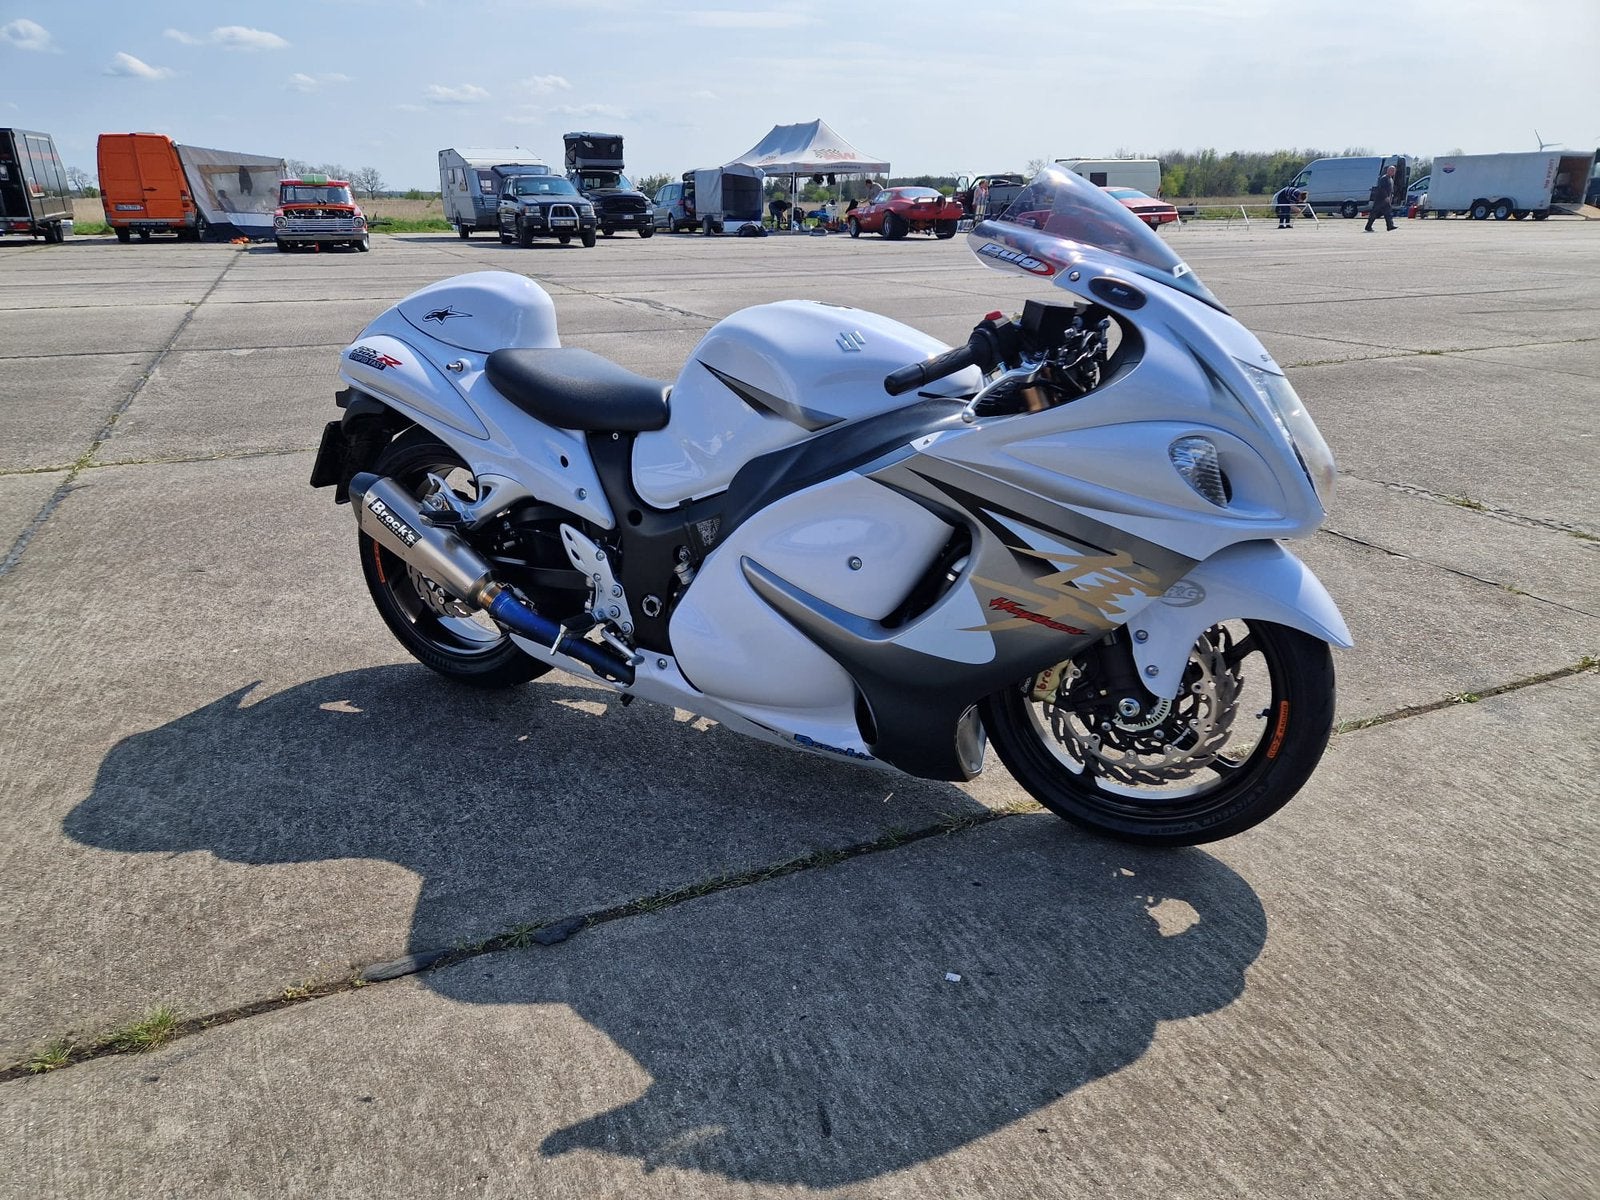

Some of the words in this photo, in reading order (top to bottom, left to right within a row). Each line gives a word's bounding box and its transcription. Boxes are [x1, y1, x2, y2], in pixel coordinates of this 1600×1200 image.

[977, 242, 1042, 270] Puig
[368, 358, 387, 370] FAST
[370, 500, 416, 543] Brock's
